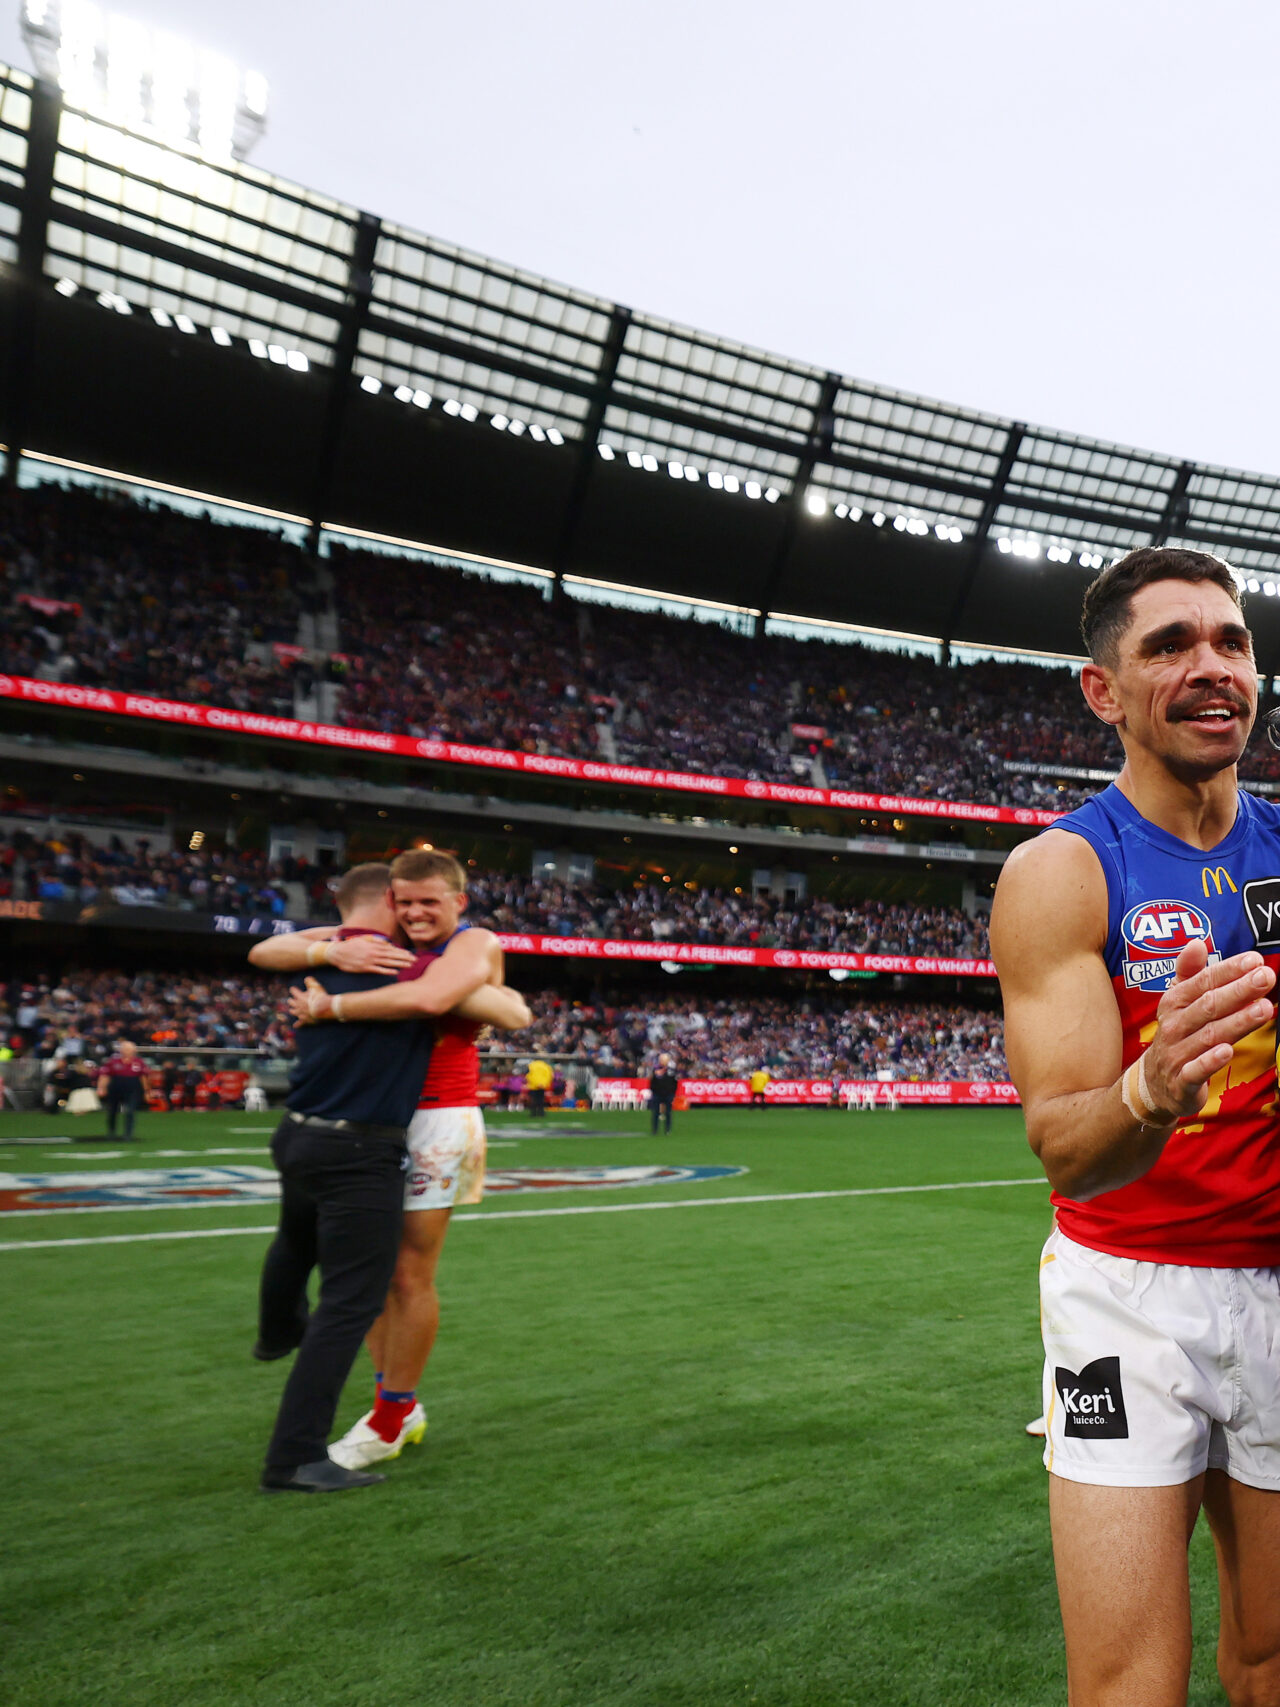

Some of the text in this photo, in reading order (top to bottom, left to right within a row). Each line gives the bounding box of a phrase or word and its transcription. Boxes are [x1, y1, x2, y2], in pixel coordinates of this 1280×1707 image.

[19, 681, 396, 750] TOYOTA FOOTY. OH WHAT A FEELING!
[448, 745, 728, 791] TOYOTA FOOTY. OH WHAT A FEELING!
[770, 785, 999, 819] TOYOTA FOOTY. OH WHAT A FEELING!
[1132, 911, 1206, 942] AFL
[541, 938, 597, 954] FOOTY.
[603, 942, 629, 955] OH
[630, 943, 677, 957] WHAT
[678, 946, 690, 958] A
[692, 947, 755, 963] FEELING!
[798, 952, 856, 968] TOYOTA
[864, 956, 911, 970] FOOTY.
[915, 958, 937, 971] OH
[937, 959, 976, 973] WHAT
[976, 961, 987, 973] A
[1128, 958, 1175, 984] GRAND
[682, 1081, 748, 1095] TOYOTA
[893, 1083, 950, 1096] FEELING!
[1062, 1387, 1115, 1414] Keri
